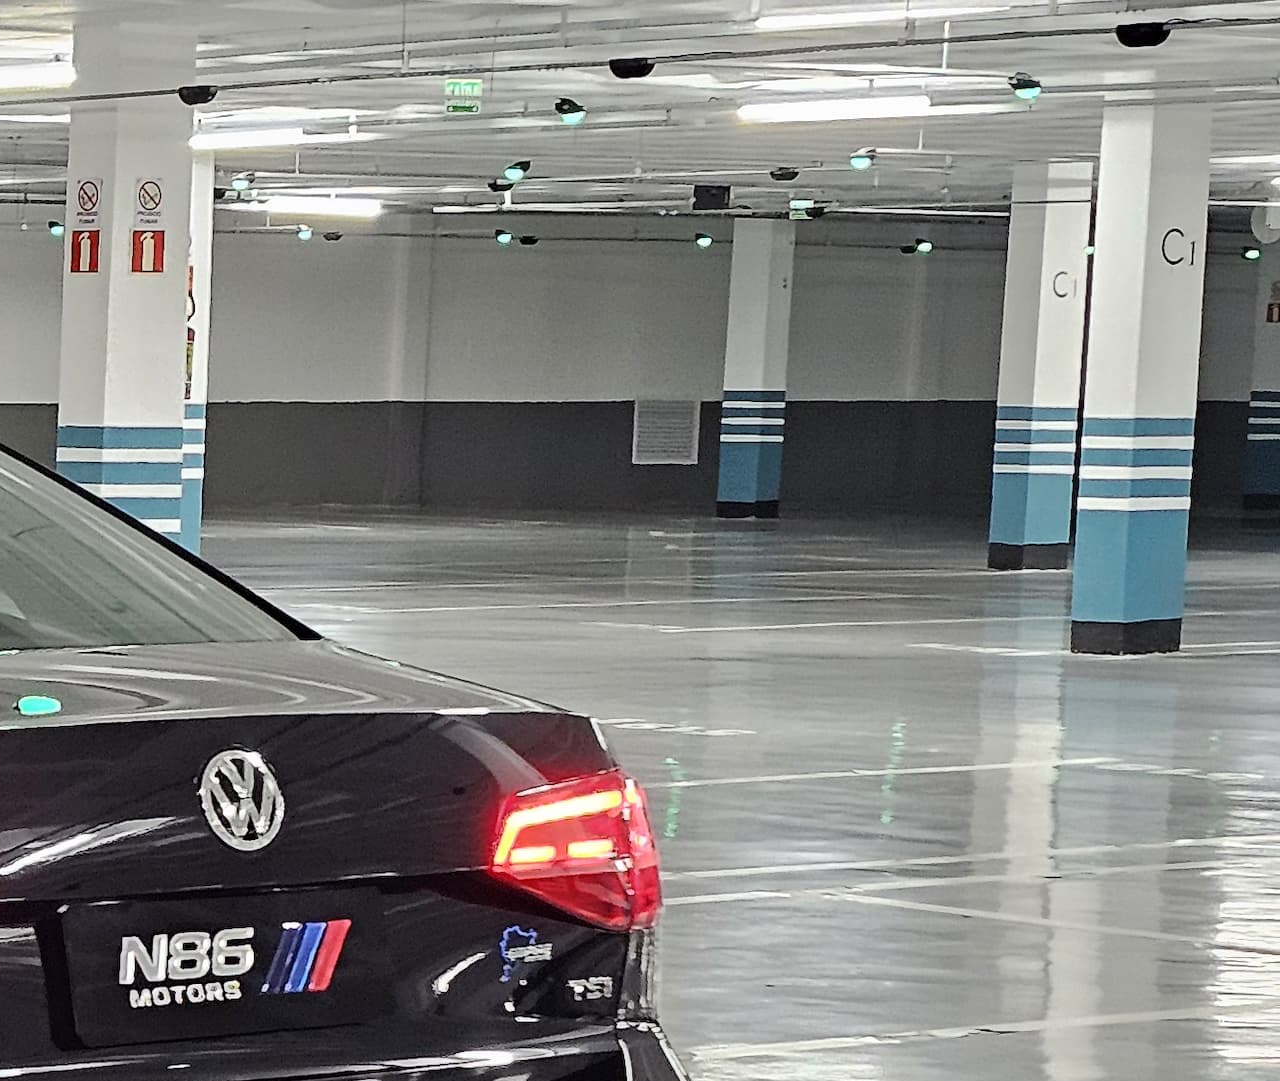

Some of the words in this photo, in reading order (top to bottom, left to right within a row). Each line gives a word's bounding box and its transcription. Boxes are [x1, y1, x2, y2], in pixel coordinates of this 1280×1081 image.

[1161, 228, 1196, 266] C1
[118, 926, 255, 985] N86
[129, 979, 242, 1008] MOTORS
